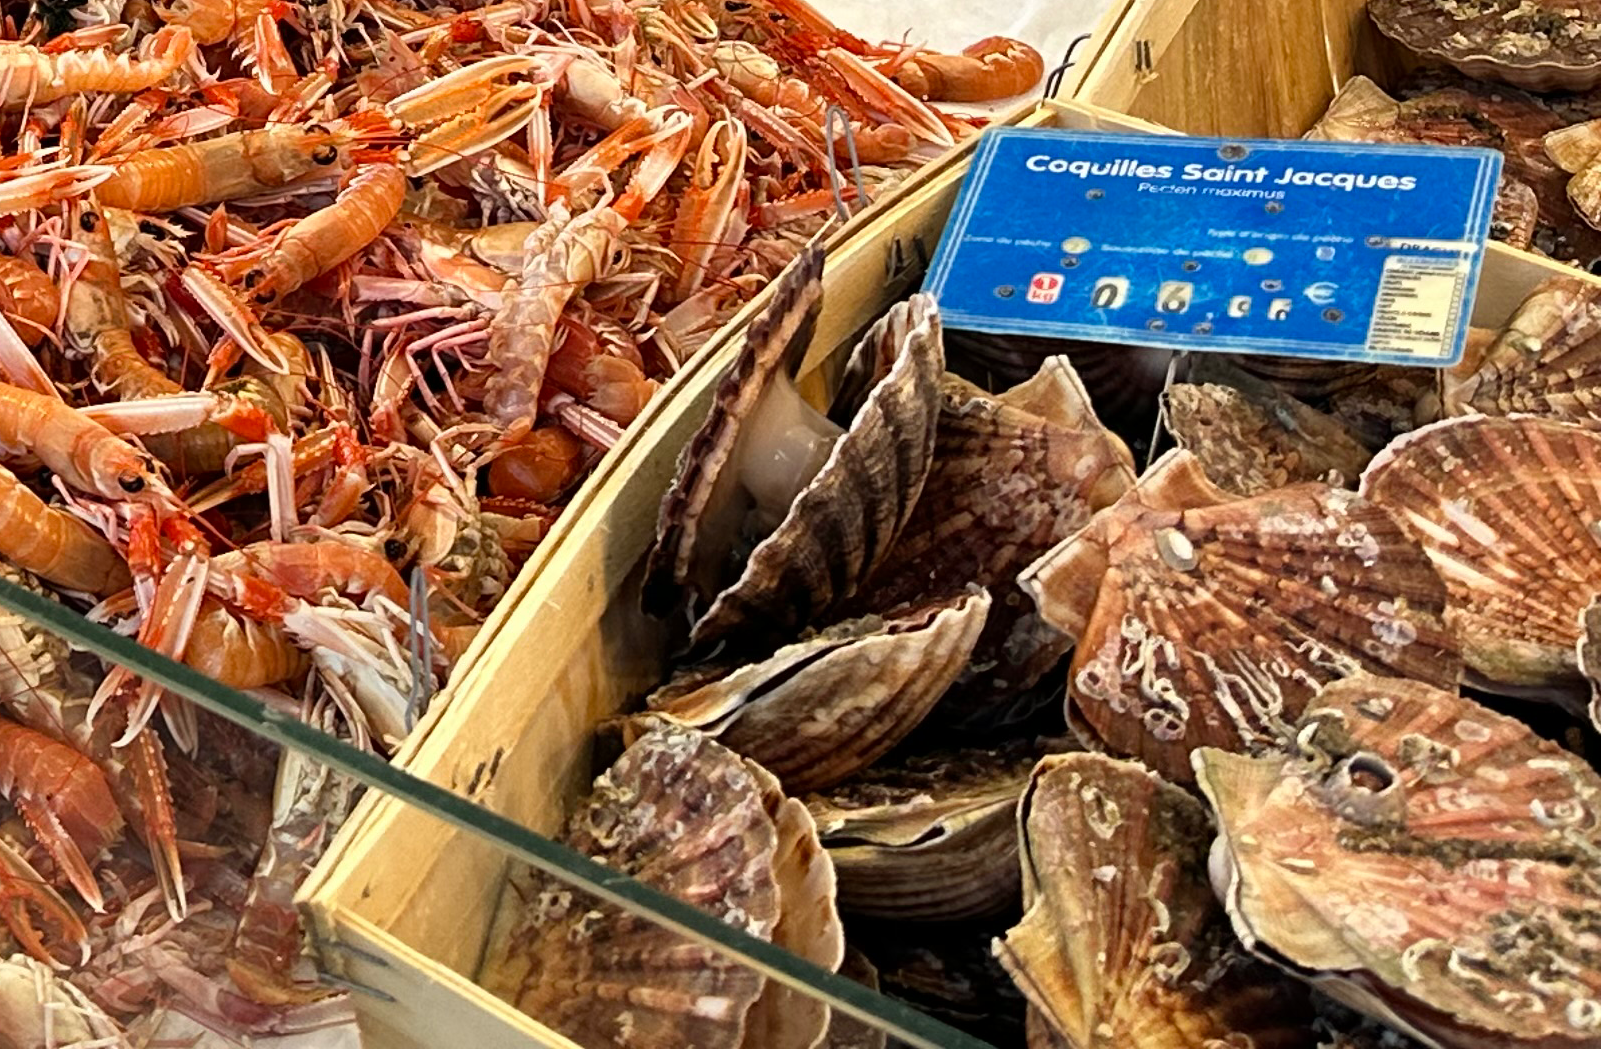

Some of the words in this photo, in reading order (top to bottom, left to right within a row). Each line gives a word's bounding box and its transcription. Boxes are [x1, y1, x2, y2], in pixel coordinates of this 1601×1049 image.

[1025, 154, 1173, 179] Coquilles
[1181, 162, 1270, 184] Saint
[1273, 167, 1418, 192] Jacques
